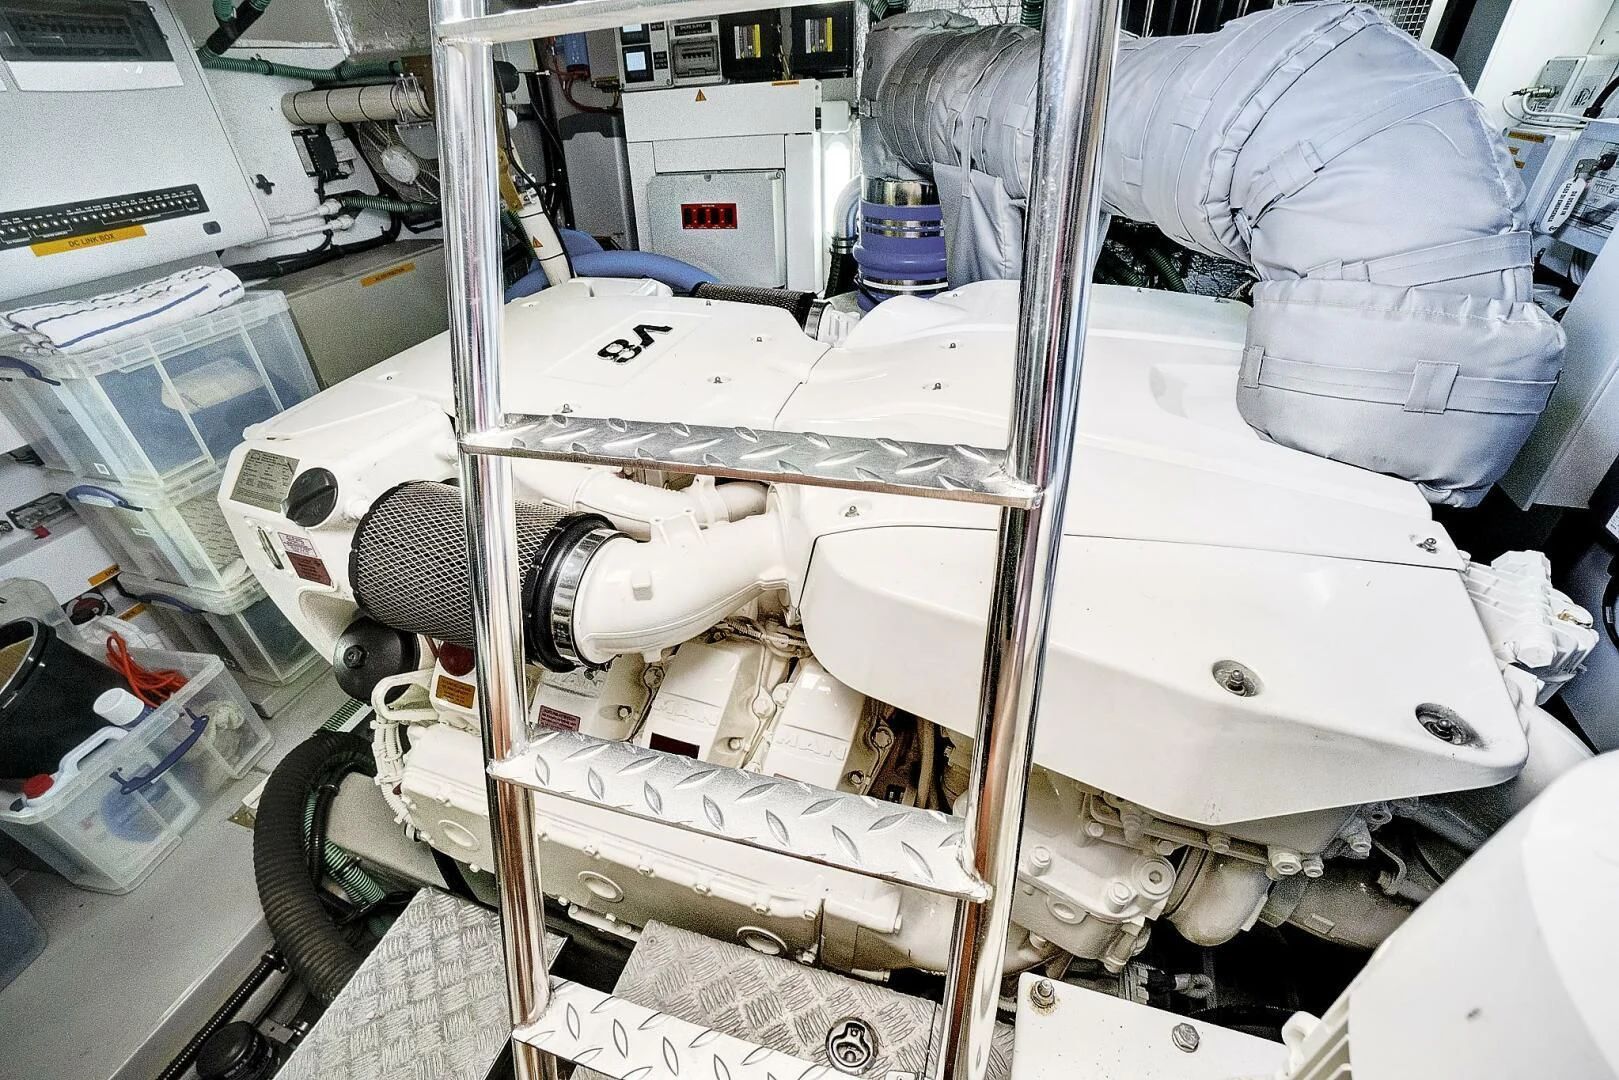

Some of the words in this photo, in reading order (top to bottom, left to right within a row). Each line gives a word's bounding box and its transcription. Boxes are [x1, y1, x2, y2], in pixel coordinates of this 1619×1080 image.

[81, 236, 99, 245] LINK
[99, 233, 115, 242] BOX
[597, 324, 673, 363] V8
[652, 699, 717, 726] MAN
[776, 736, 847, 761] MAN
